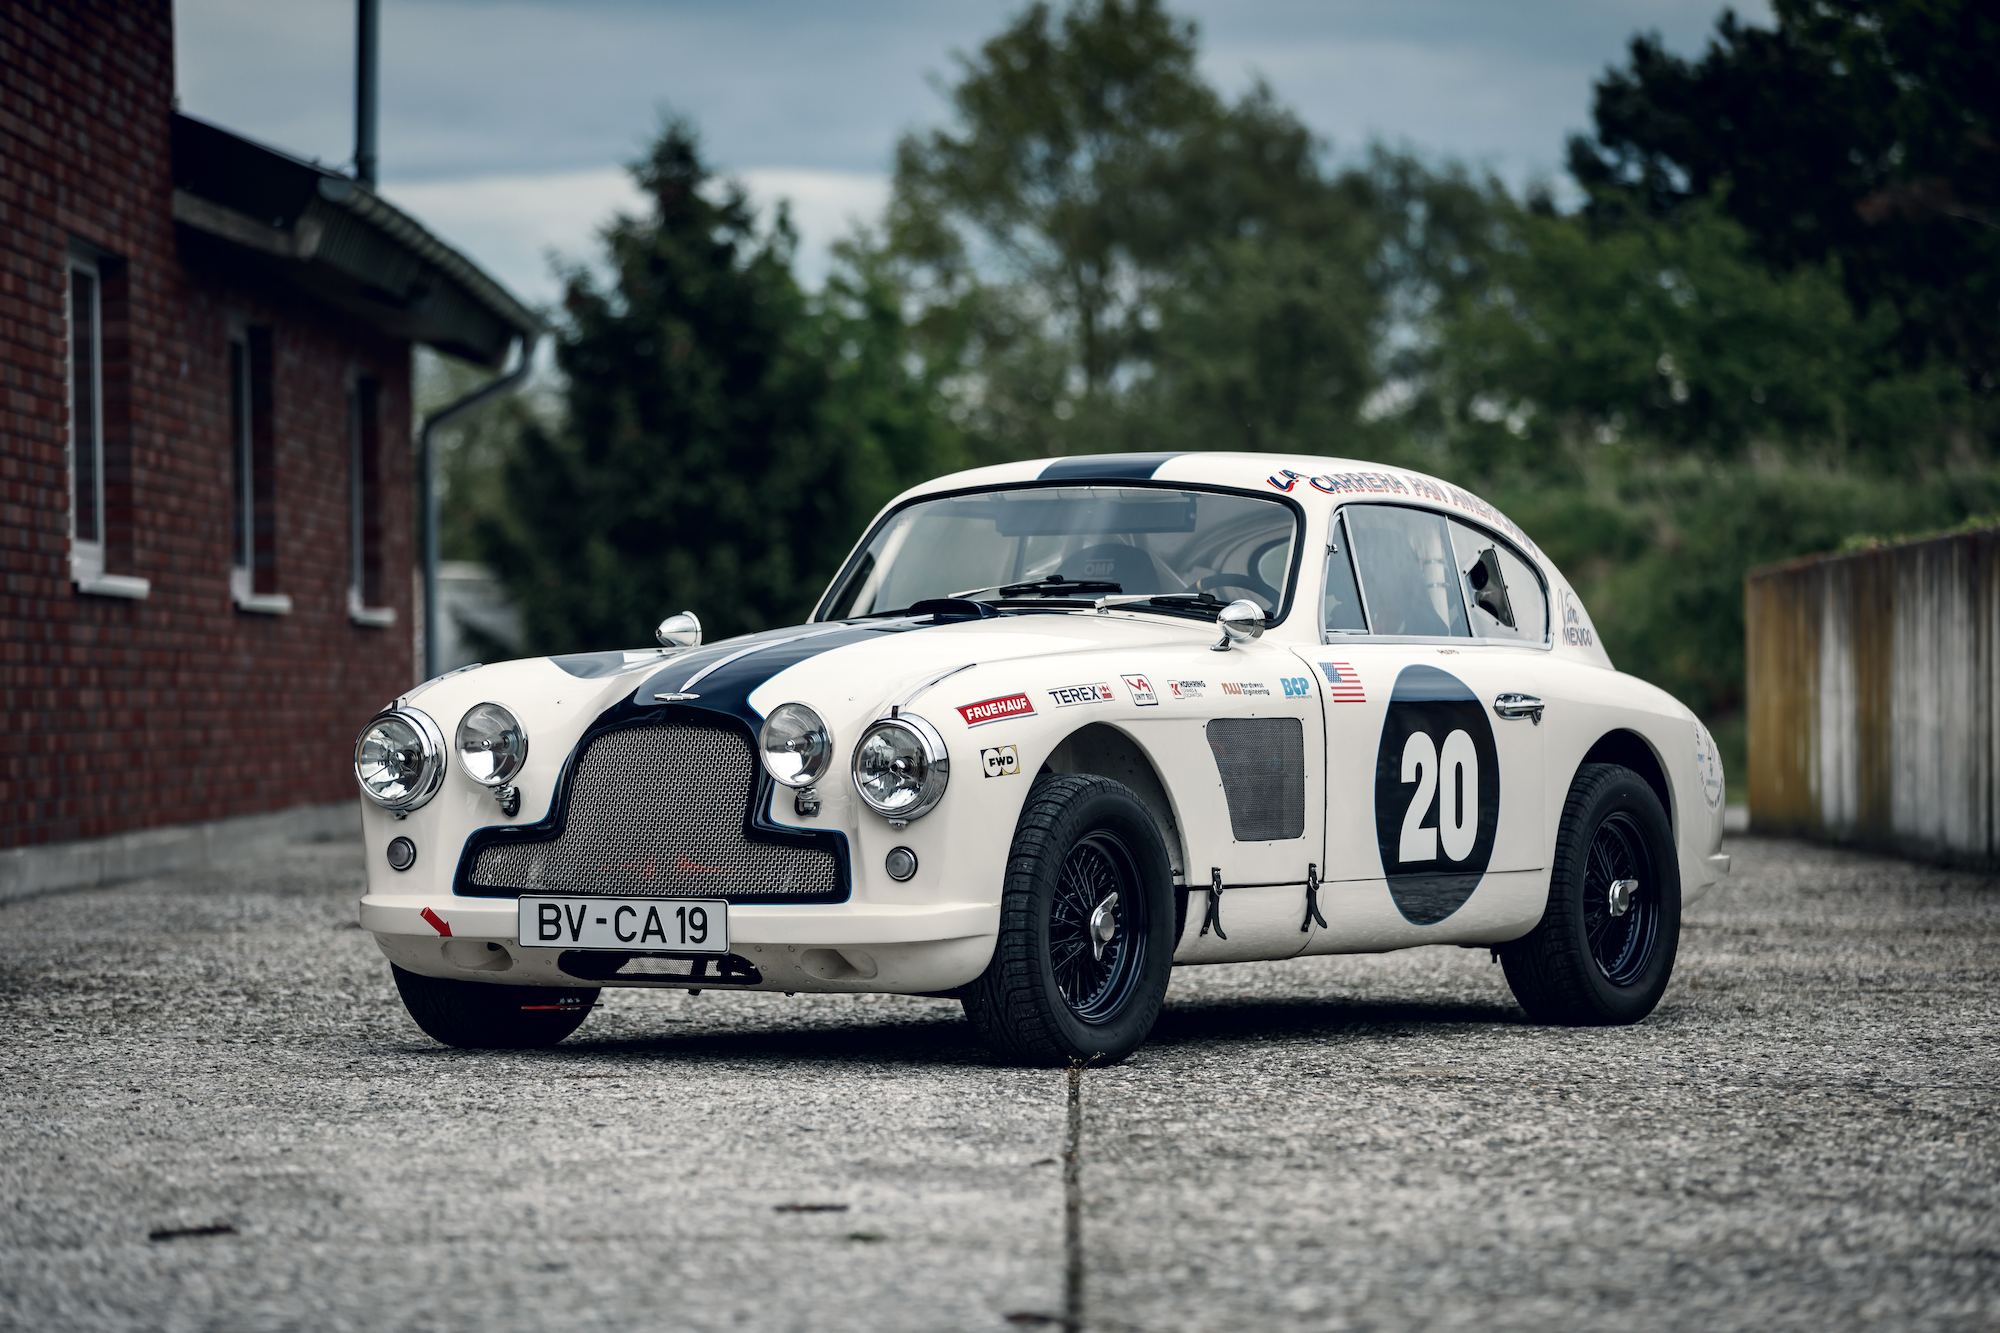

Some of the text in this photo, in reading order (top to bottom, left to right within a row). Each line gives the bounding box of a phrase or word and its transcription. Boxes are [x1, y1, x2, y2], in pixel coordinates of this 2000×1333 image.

[1309, 472, 1409, 494] CARRERA
[1403, 475, 1448, 503] PAN
[1084, 563, 1115, 576] OMP
[1048, 686, 1101, 705] TEREX
[1280, 677, 1310, 696] BCP
[965, 697, 1028, 721] FRUEHAUF
[988, 755, 1014, 768] FWD
[1399, 728, 1479, 864] 20
